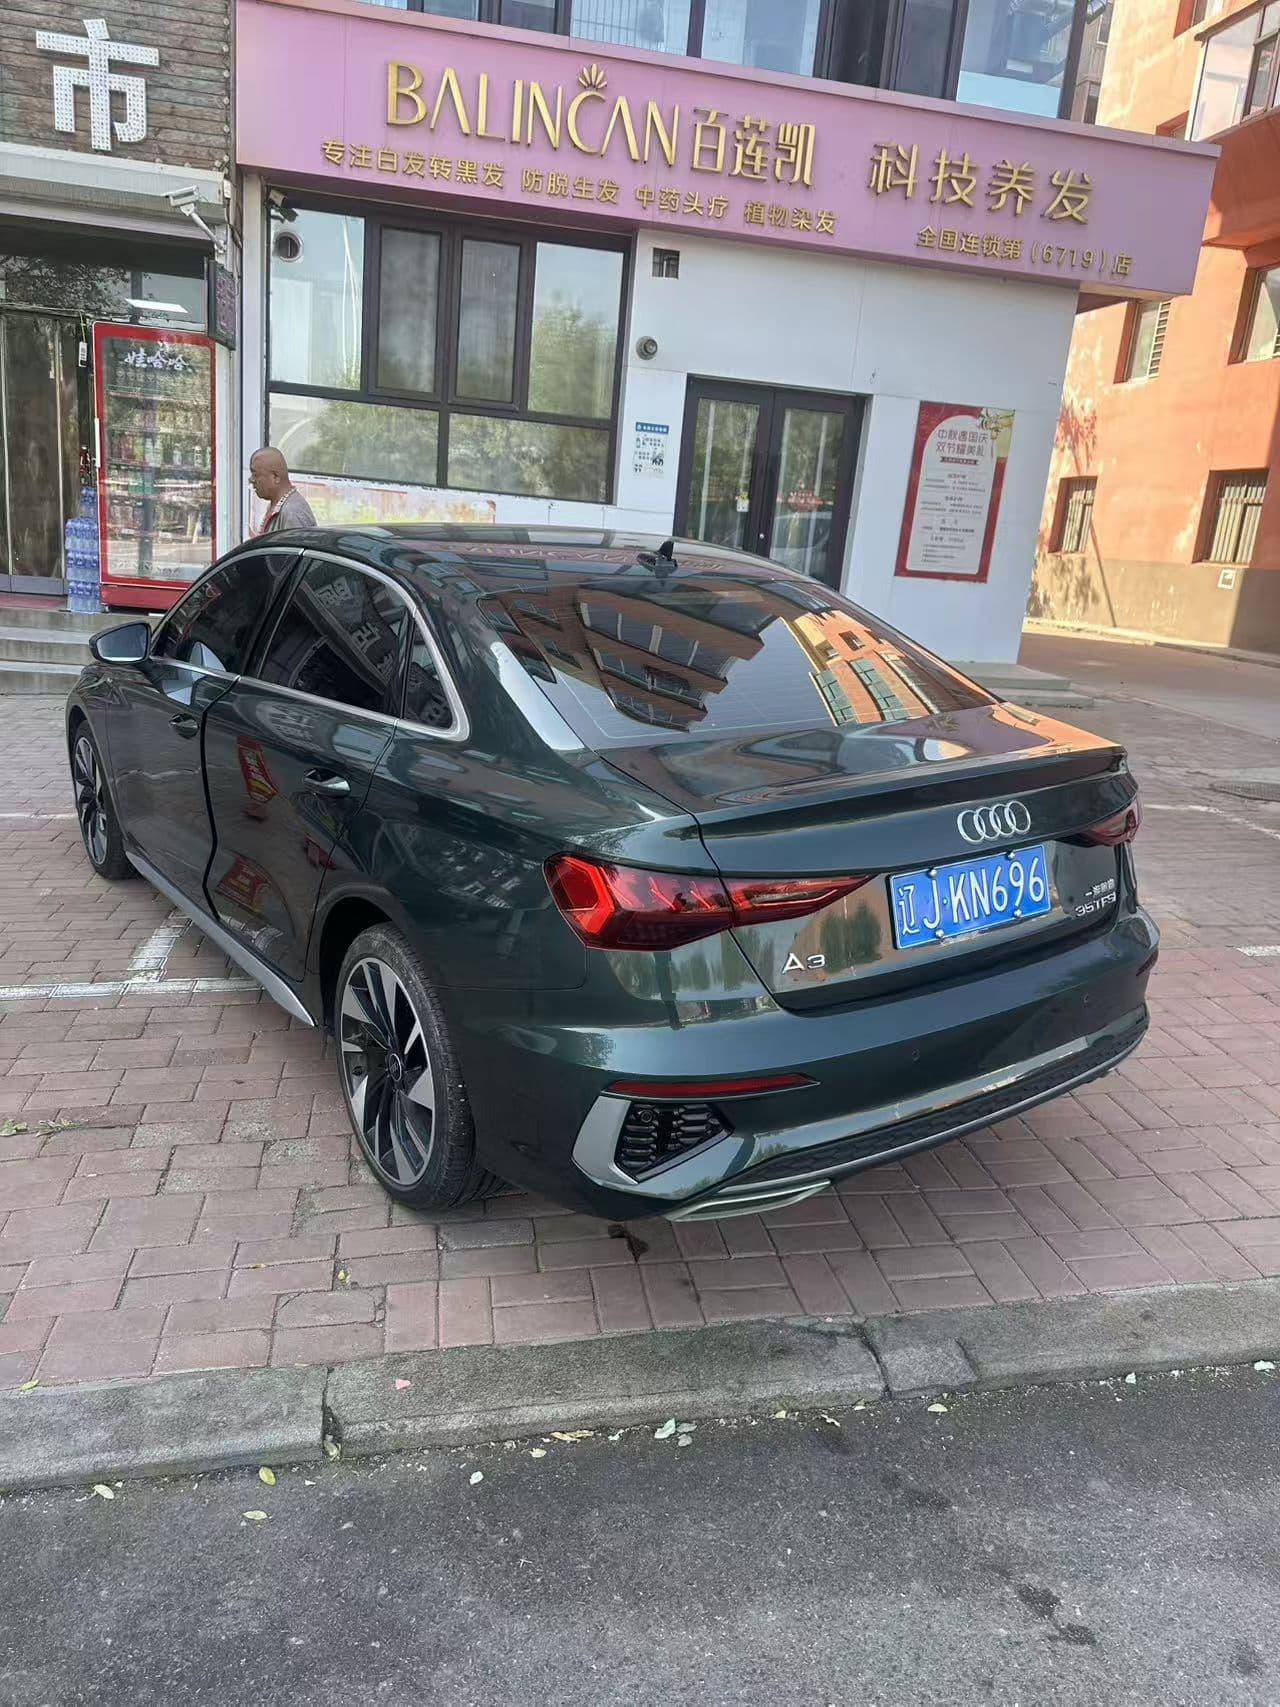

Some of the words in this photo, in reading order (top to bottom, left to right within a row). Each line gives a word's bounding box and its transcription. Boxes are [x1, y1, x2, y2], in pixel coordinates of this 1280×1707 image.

[36, 18, 160, 150] 市
[321, 140, 505, 189] 专注白发转黑发
[521, 168, 619, 205] 防脱生发
[635, 185, 729, 219] 中药头疗
[744, 200, 836, 236] 植物染发
[386, 62, 680, 167] BALINCAN
[691, 107, 816, 189] 百莲凯
[867, 143, 1093, 225] 科技养发
[124, 346, 190, 371] 娃哈哈
[781, 952, 826, 974] A3
